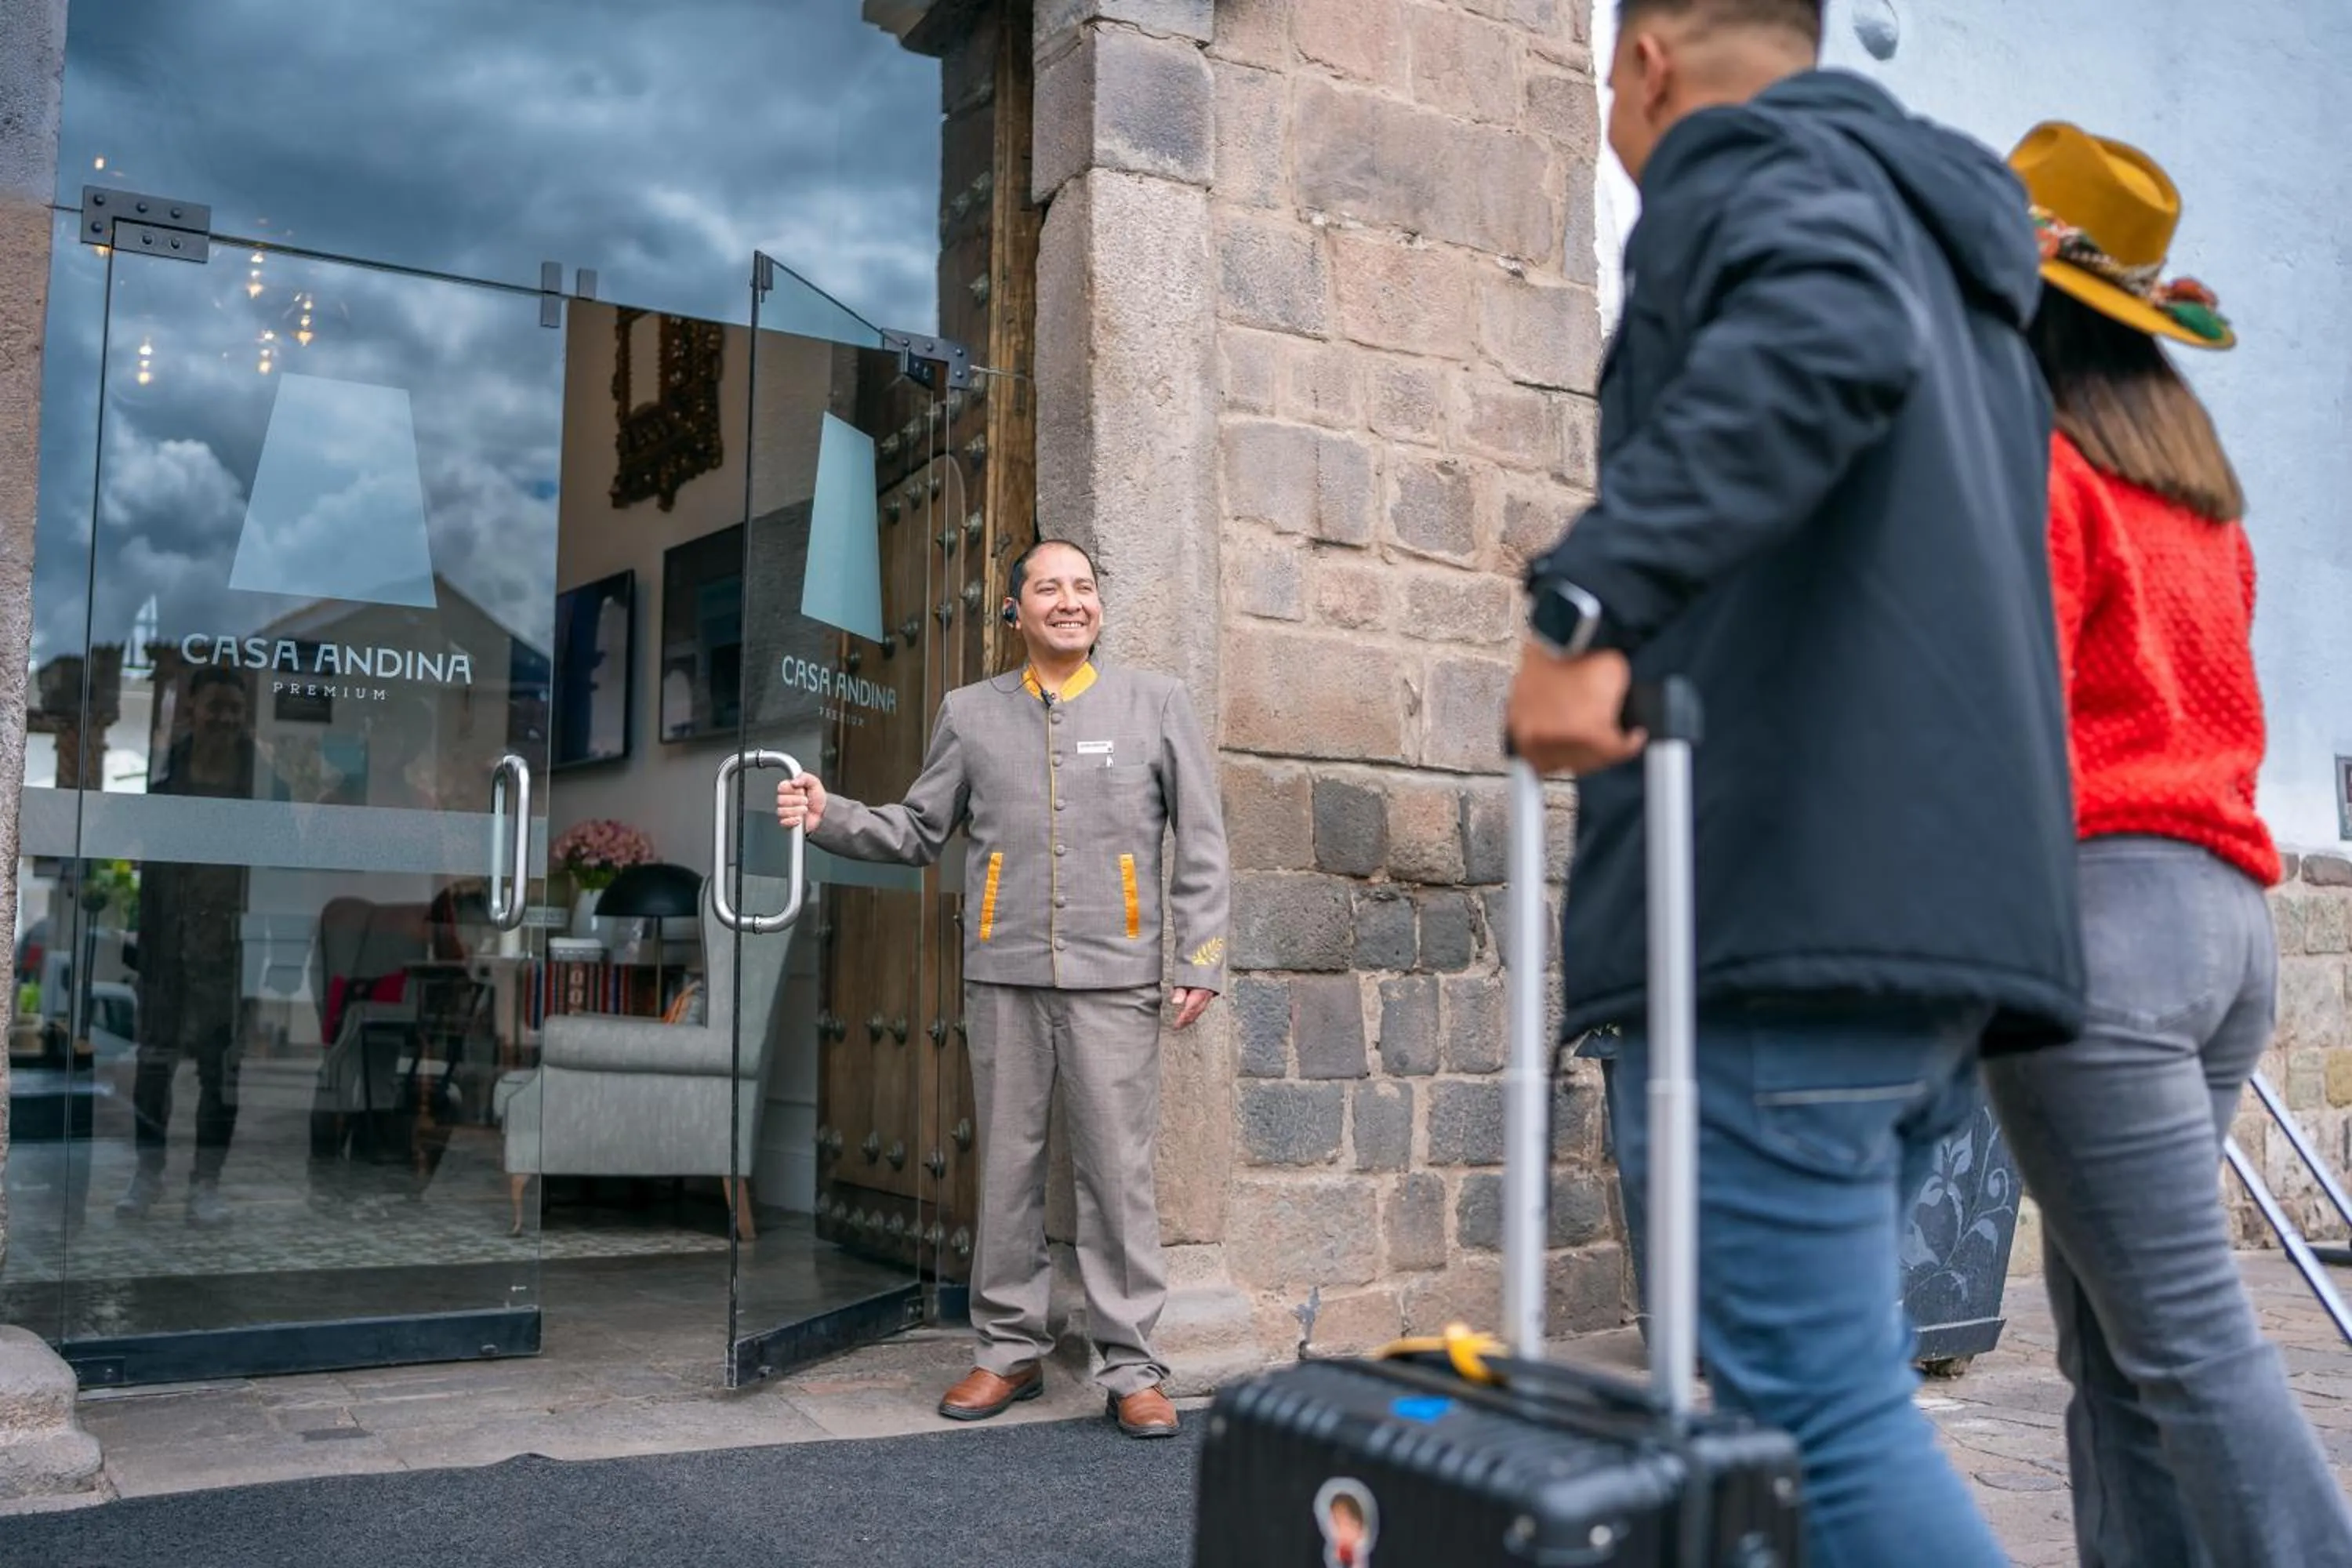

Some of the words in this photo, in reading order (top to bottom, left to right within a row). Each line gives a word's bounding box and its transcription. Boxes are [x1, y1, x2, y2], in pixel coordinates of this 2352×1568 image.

[181, 633, 299, 671] CASA
[314, 643, 472, 684] ANDINA
[273, 681, 386, 700] PREMIUM
[782, 655, 830, 696] CASA
[835, 672, 896, 716] ANDINA
